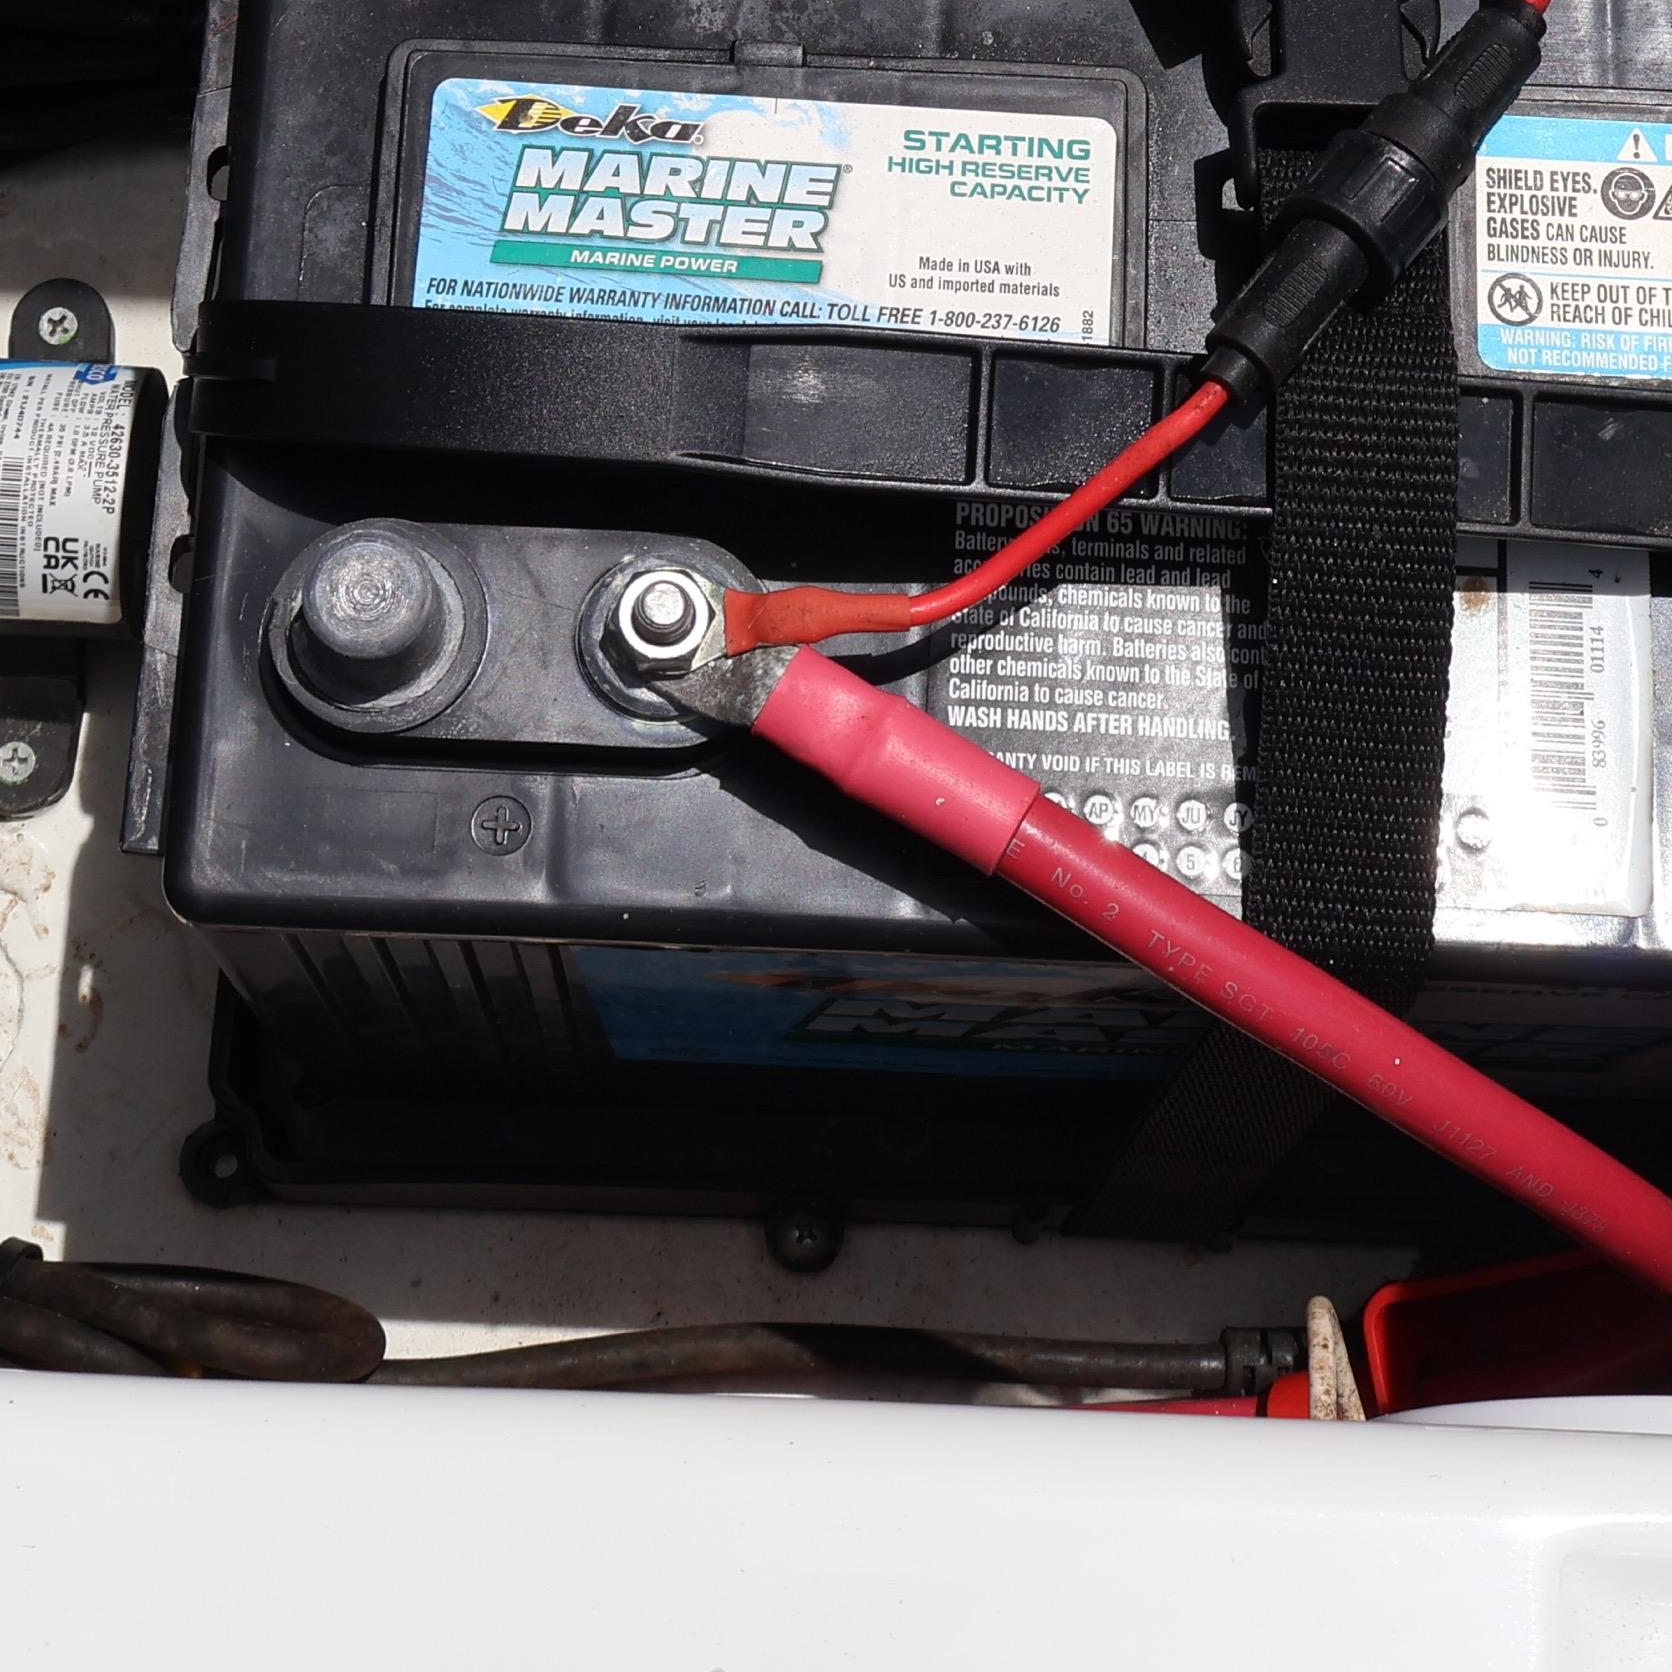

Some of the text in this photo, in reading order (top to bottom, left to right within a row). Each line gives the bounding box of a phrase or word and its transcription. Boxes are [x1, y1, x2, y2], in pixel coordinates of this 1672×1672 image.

[492, 96, 699, 143] Deka
[902, 129, 1091, 161] STARTING
[513, 145, 841, 209] MARINE
[888, 156, 1091, 185] HIGH RESERVE
[1485, 167, 1598, 195] SHIELD EYES.
[949, 181, 1091, 205] CAPACITY
[1486, 192, 1578, 218] EXPLOSIVE
[500, 190, 828, 253] MASTER
[1486, 216, 1627, 245] GASES CAN CAUSE
[569, 248, 739, 274] MARINE POWER
[918, 256, 1032, 276] Made in USA with
[1486, 243, 1655, 270] BLINDNESS OR INJURY.
[888, 273, 1061, 298] US and imported materials
[1550, 281, 1591, 302] KEEP
[1596, 283, 1631, 303] OUT
[1636, 286, 1658, 305] OF
[426, 277, 458, 297] FOR
[460, 278, 566, 305] NATIONWIDE
[568, 286, 662, 309] WARRANTY
[664, 292, 776, 317] INFORMATION
[779, 300, 822, 320] CALL:
[826, 302, 872, 322] TOLL
[877, 306, 924, 325] FREE
[929, 309, 1061, 334] 1-800-237-6126
[1550, 304, 1605, 325] REACH
[1612, 307, 1633, 326] OF
[94, 412, 113, 468] PRESSURE
[101, 423, 124, 516] 42630-3512-2P
[91, 470, 105, 505] PUMP
[1107, 510, 1248, 541] 65 WARNING:
[42, 535, 59, 570] CA
[61, 536, 79, 572] UK
[1071, 540, 1247, 566] terminals and related
[1591, 625, 1607, 674] 01114
[949, 654, 1260, 689] other chemicals known to the State of
[948, 677, 1168, 709] California to cause cancer.
[947, 705, 1237, 741] WASH HANDS AFTER HANDLING.
[1591, 718, 1608, 771] 83996
[1041, 752, 1217, 780] VOID IF THIS LABEL IS
[1049, 867, 1091, 906] No.
[1100, 900, 1120, 923] 2
[1145, 930, 1213, 986] TYPE
[1219, 980, 1275, 1025] SGT
[1290, 1027, 1352, 1072] 105C
[1367, 1074, 1415, 1109] 60V
[1506, 1164, 1556, 1202] AND
